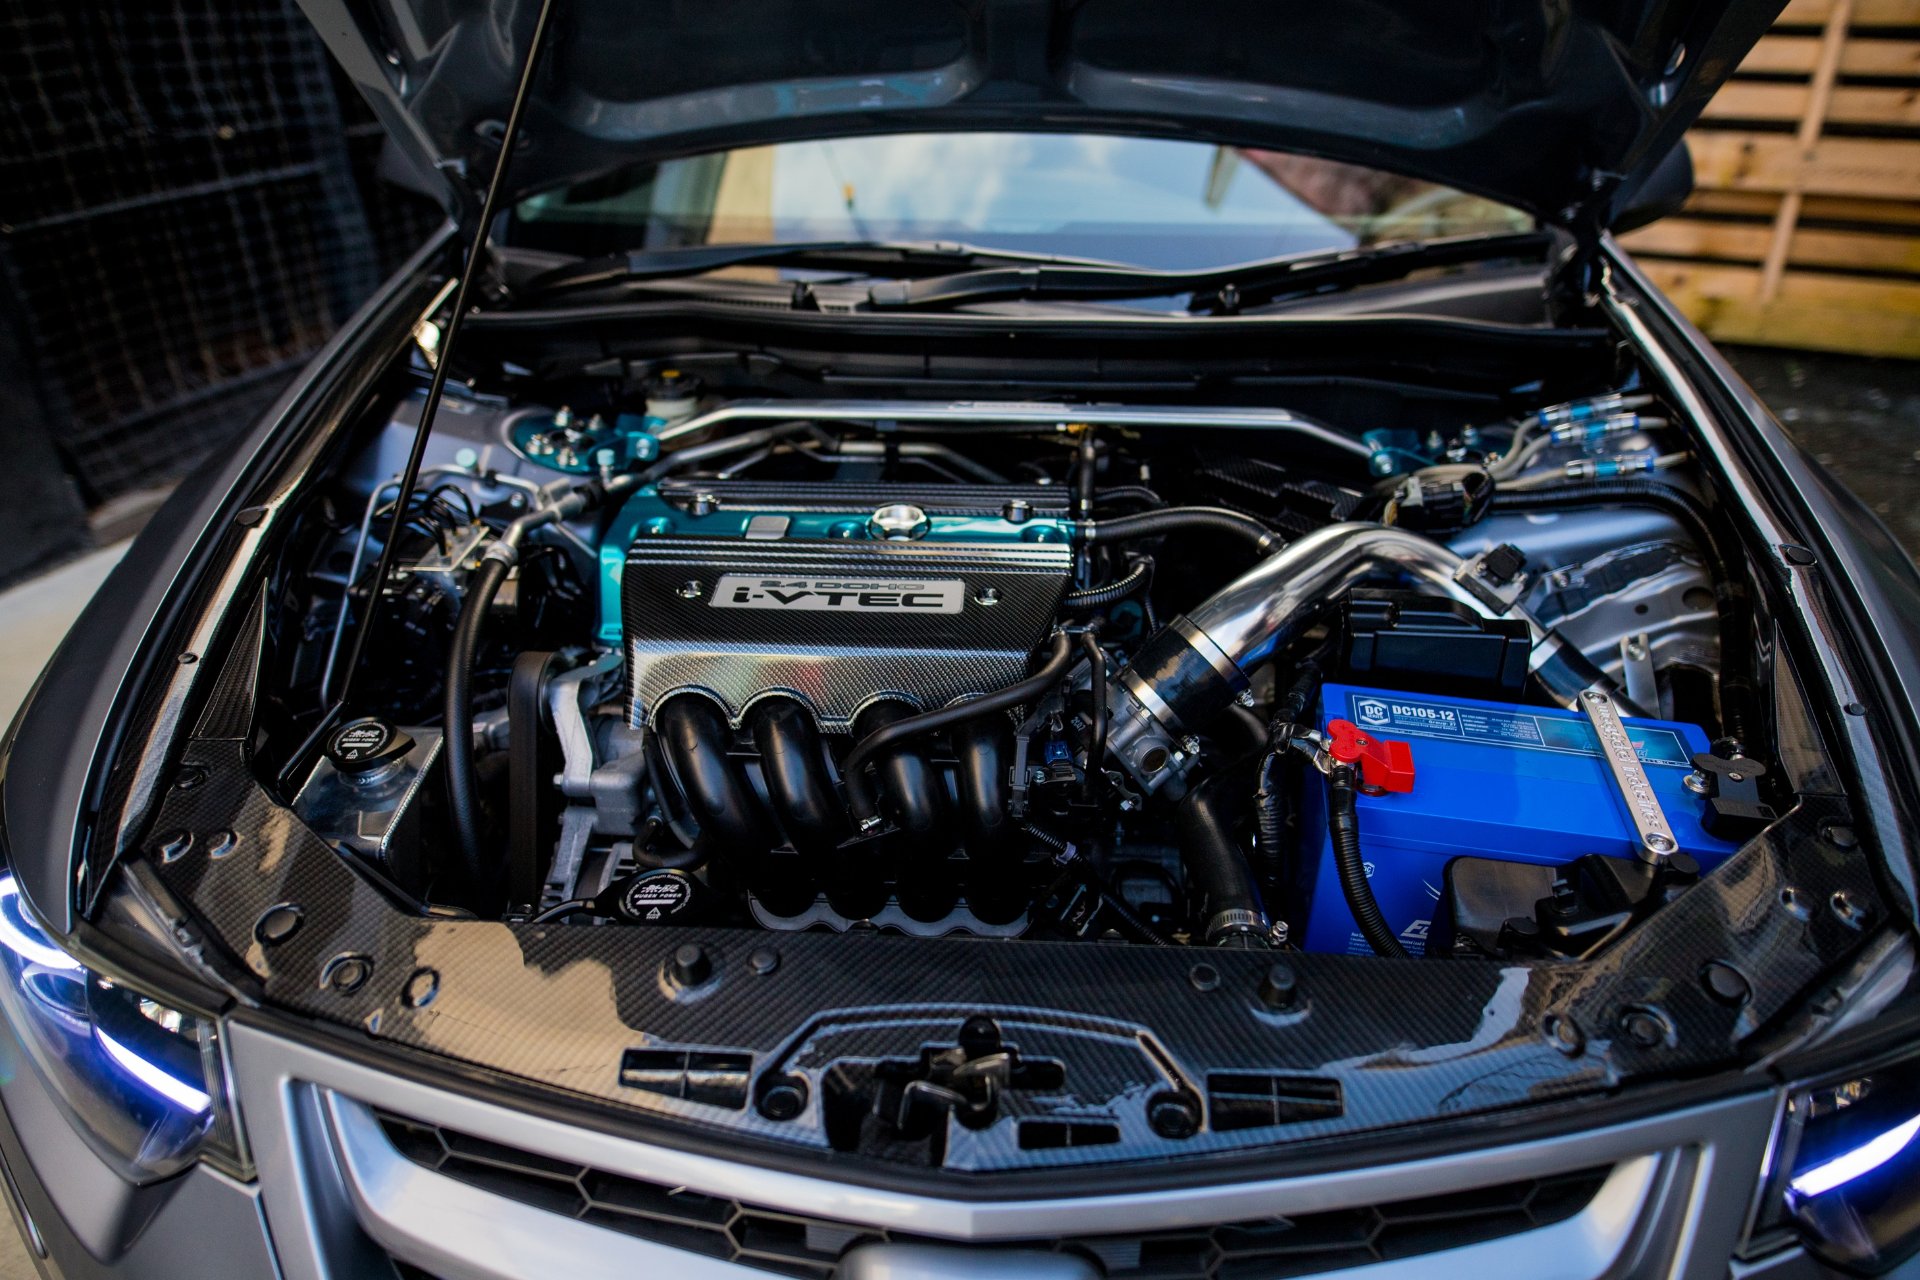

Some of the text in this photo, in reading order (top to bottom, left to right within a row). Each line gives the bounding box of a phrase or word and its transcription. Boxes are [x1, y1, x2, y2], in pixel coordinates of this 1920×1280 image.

[760, 580, 925, 591] 2.4 DOHC
[732, 586, 945, 608] i-VTEC
[1365, 705, 1383, 715] DC
[1392, 705, 1455, 721] DC105-12
